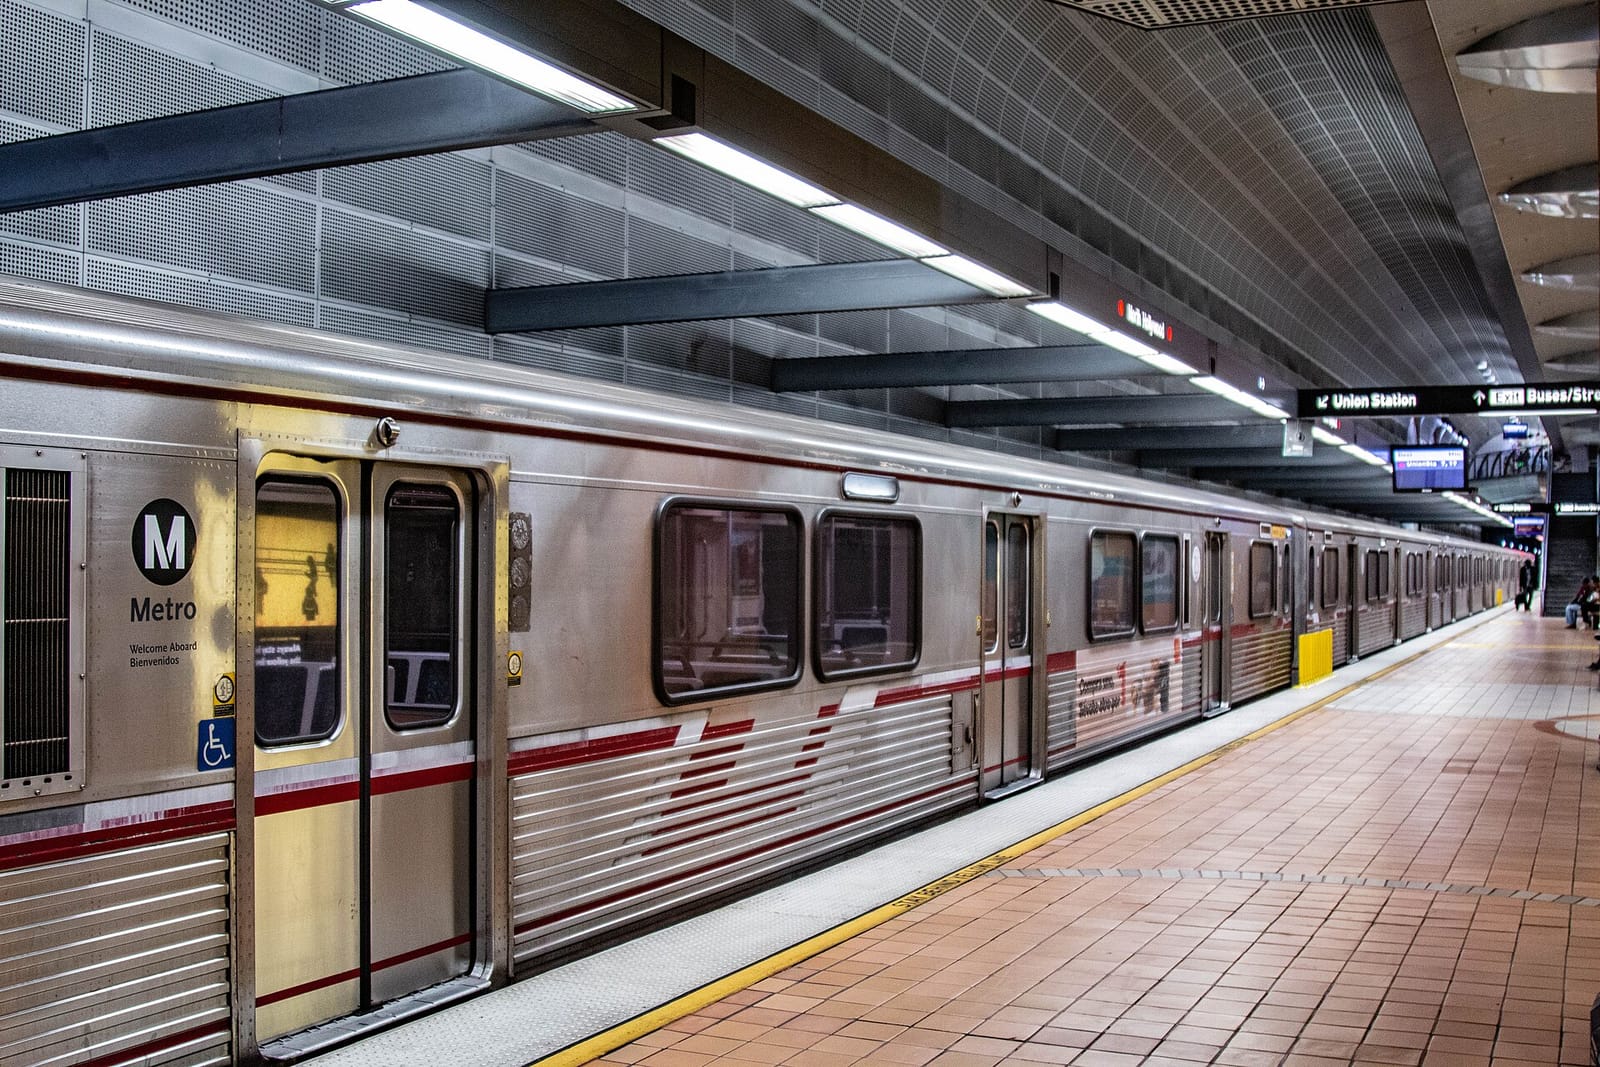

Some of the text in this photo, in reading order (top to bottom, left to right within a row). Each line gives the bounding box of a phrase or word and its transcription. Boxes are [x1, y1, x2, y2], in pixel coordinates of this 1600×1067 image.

[1332, 391, 1418, 409] Union Station
[1495, 391, 1521, 403] Exit
[144, 514, 186, 570] M
[130, 597, 197, 623] Metro
[129, 641, 198, 655] Welcome Aboard
[129, 656, 180, 668] Bienvenidos
